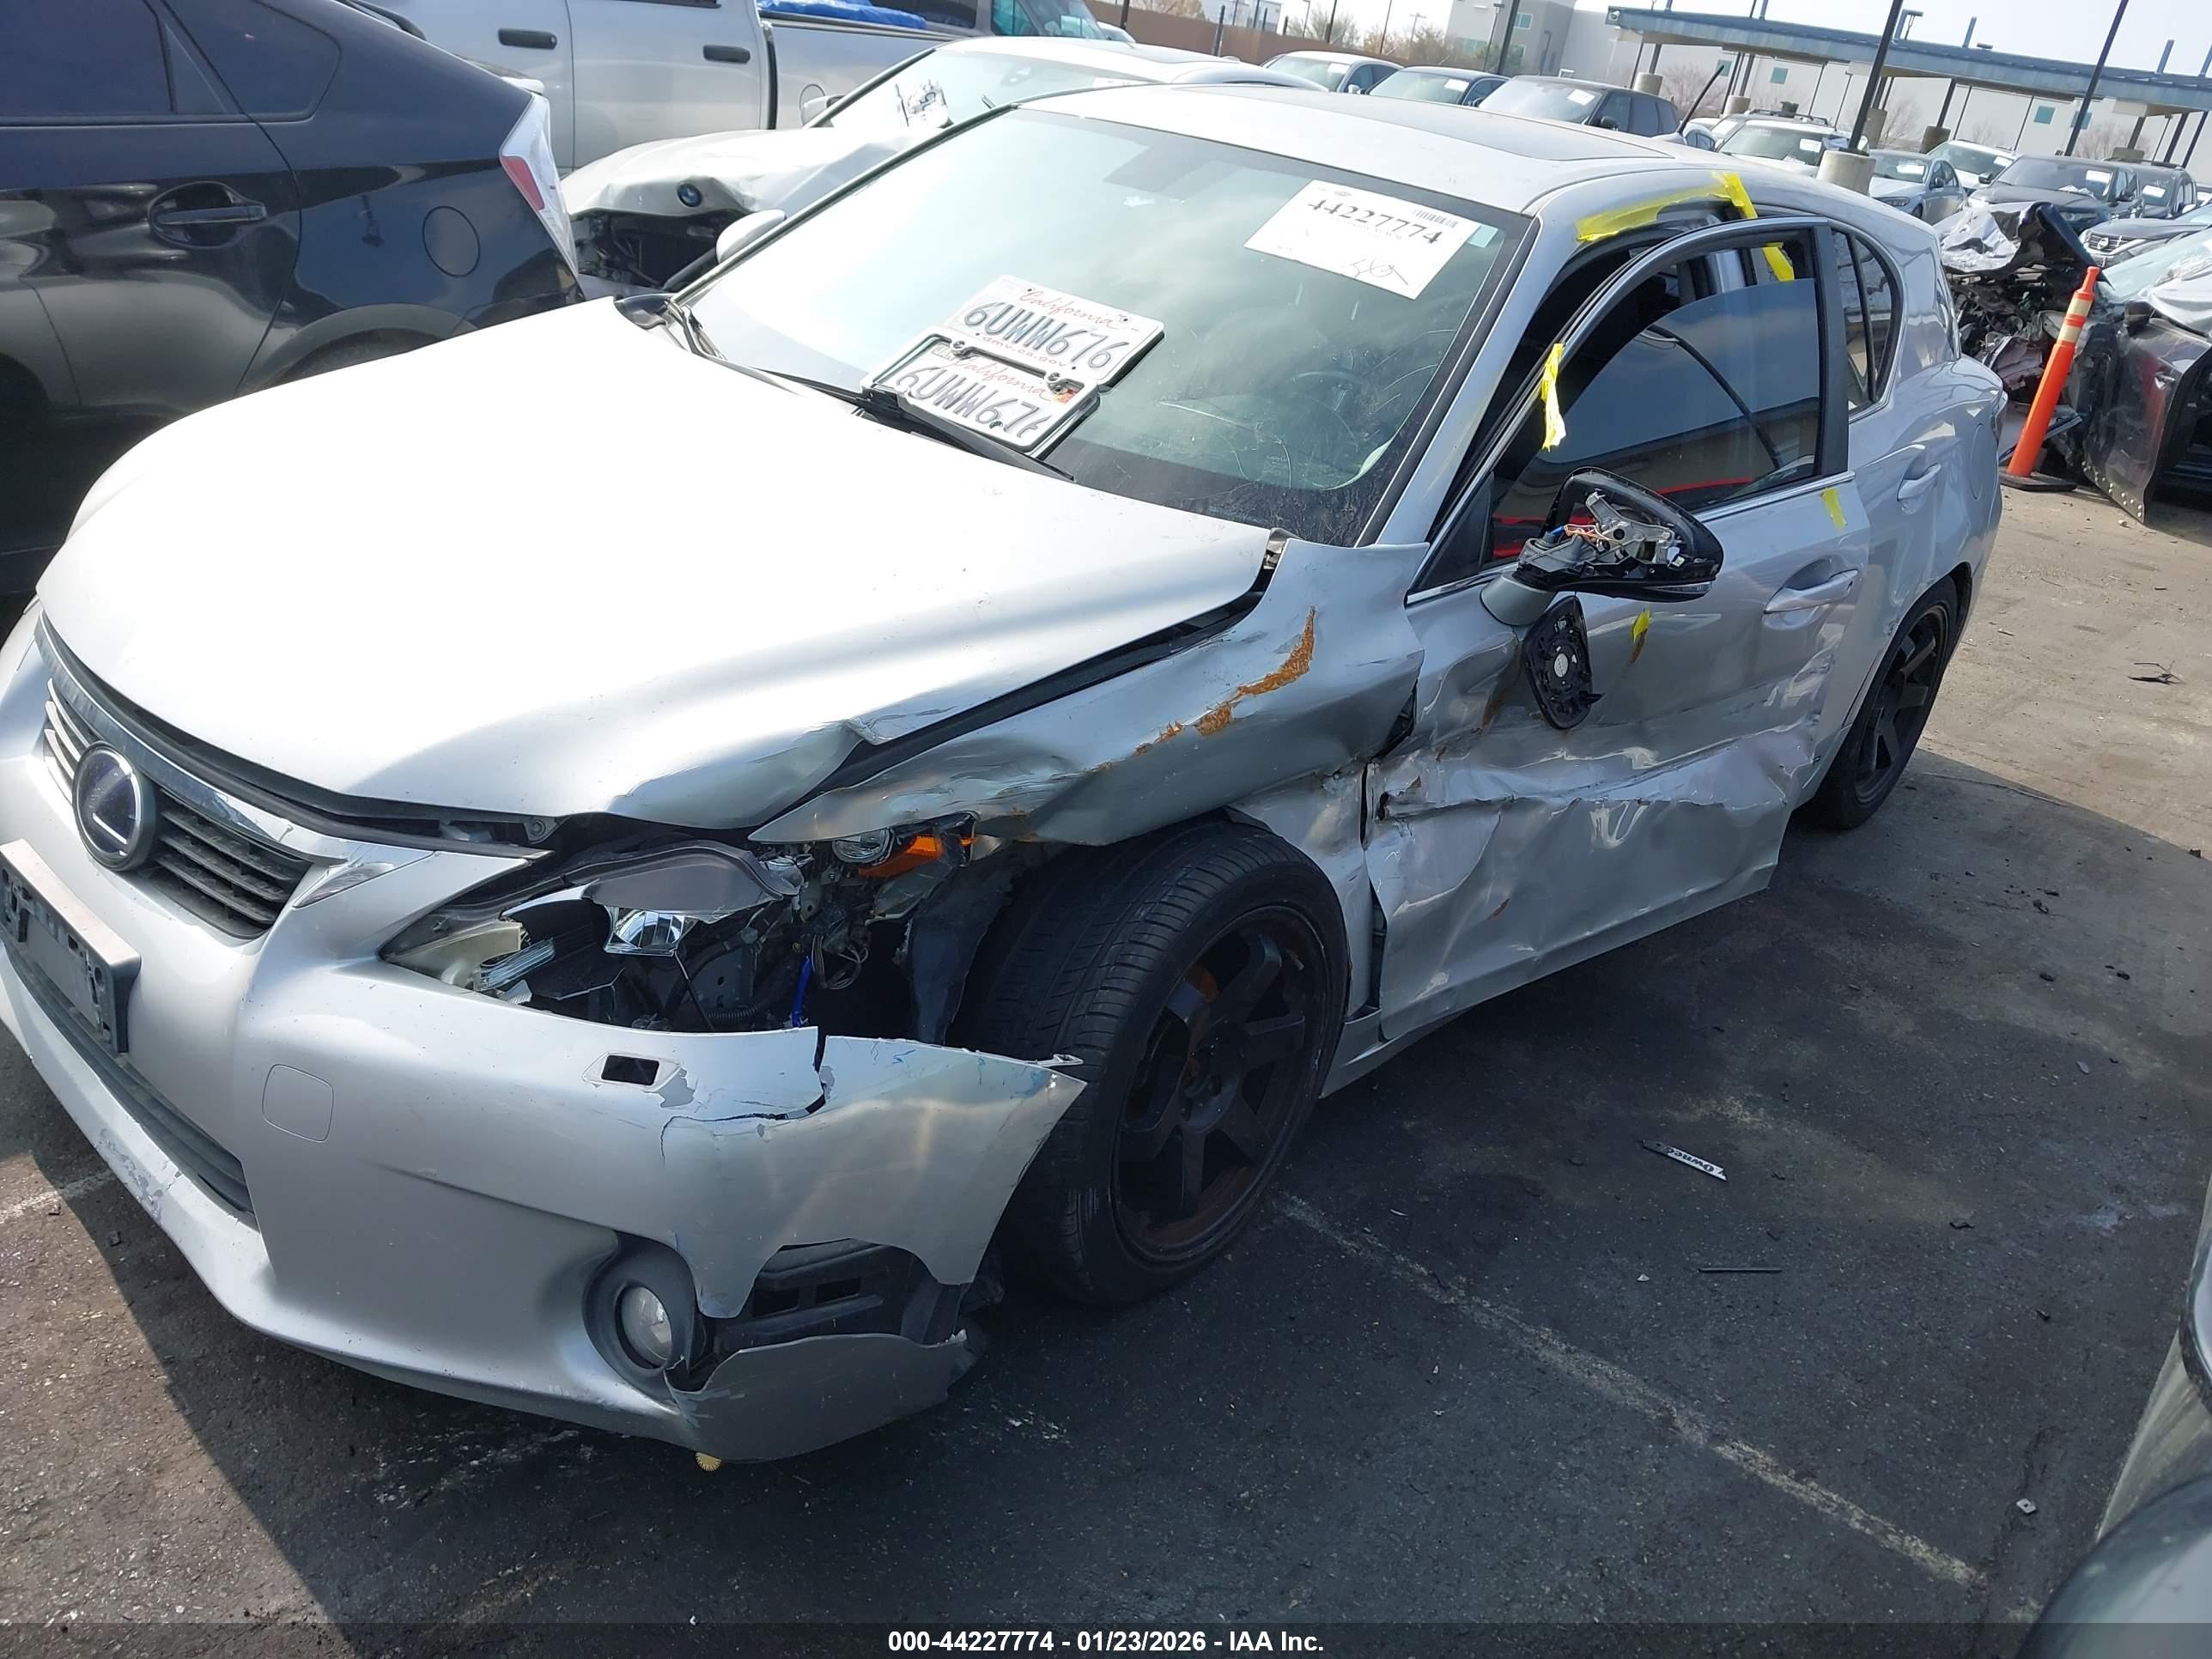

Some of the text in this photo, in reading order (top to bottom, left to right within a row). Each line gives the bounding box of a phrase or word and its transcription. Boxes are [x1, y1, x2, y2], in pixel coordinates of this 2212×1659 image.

[1307, 198, 1443, 245] 44227774
[1019, 289, 1119, 331] California
[963, 301, 1131, 369] 6UWW676
[984, 336, 1068, 367] dmv.ca.gov
